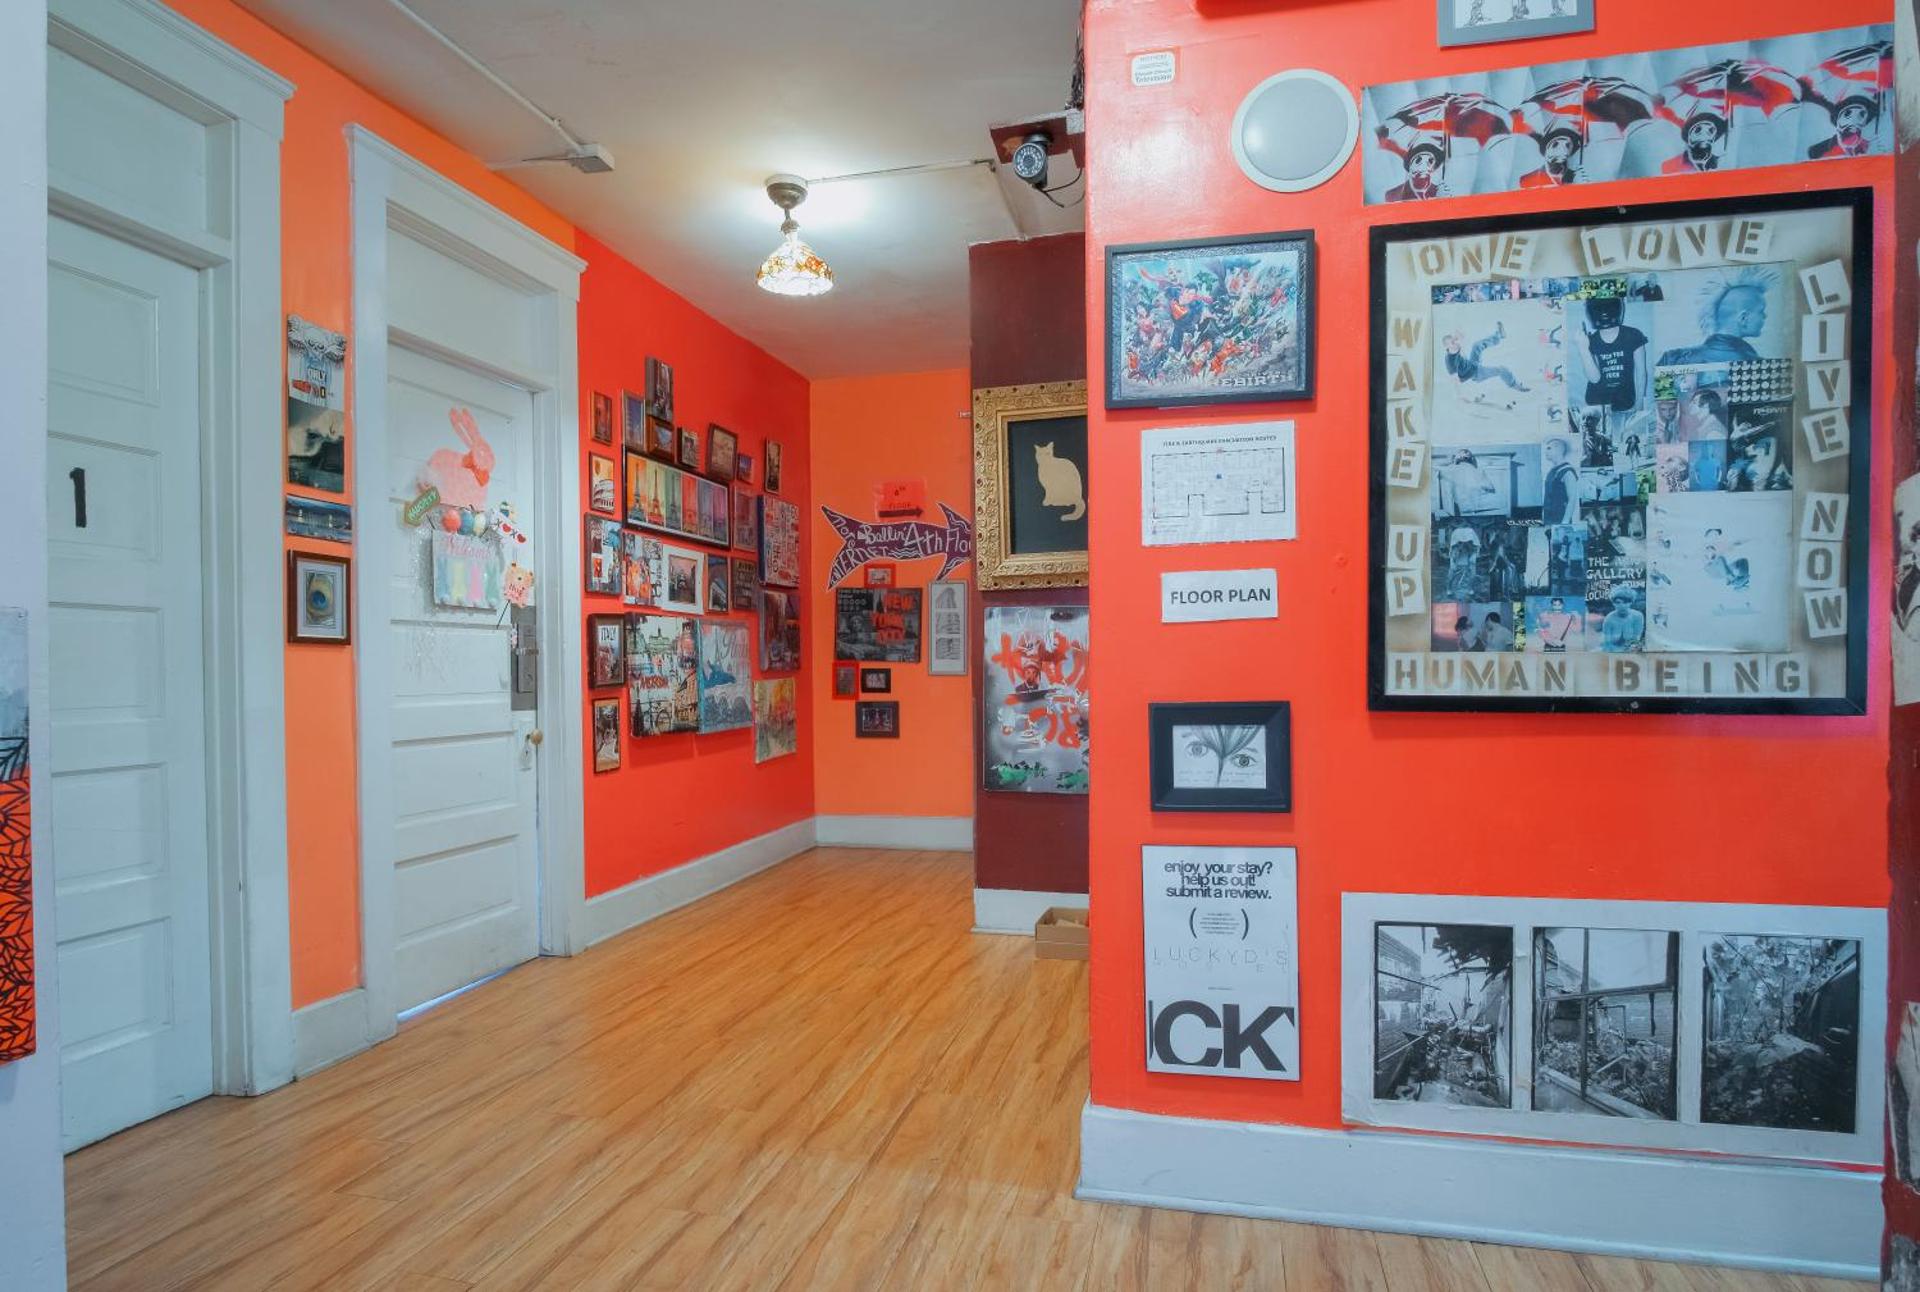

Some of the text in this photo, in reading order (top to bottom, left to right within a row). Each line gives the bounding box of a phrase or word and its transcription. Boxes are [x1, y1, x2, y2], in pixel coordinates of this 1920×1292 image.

[1421, 221, 1765, 275] ONE LOVE
[1808, 273, 1844, 453] LIVE
[1391, 318, 1422, 482] WAKE
[68, 466, 87, 529] 1
[905, 523, 942, 556] 4th
[1393, 531, 1417, 610] UP
[1586, 567, 1643, 580] GALLERY
[1587, 556, 1609, 567] THE
[1809, 498, 1845, 635] NOW
[1170, 588, 1272, 604] FLOOR PLAN
[1394, 659, 1803, 693] HUMAN BEING
[1164, 861, 1273, 877] enjoy your stay?
[1183, 874, 1256, 887] help us out!
[1166, 885, 1272, 899] submit a review.
[1148, 1000, 1295, 1072] CK
